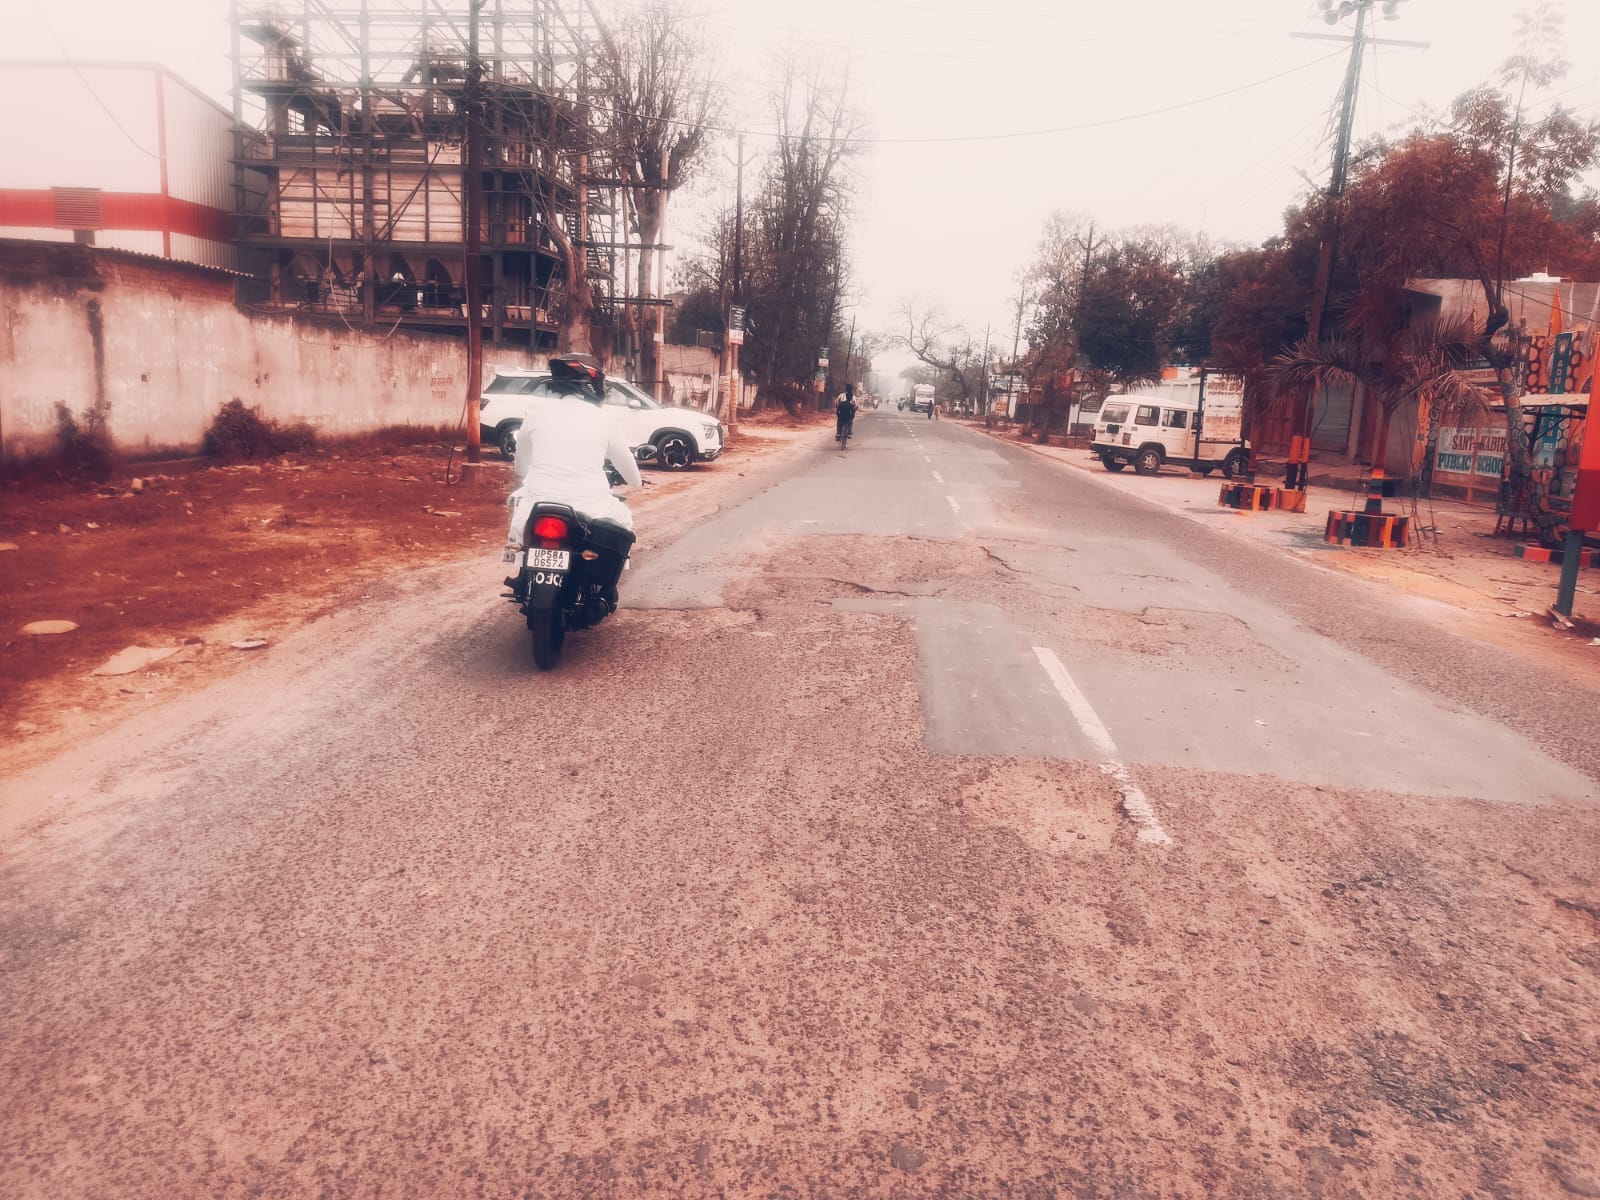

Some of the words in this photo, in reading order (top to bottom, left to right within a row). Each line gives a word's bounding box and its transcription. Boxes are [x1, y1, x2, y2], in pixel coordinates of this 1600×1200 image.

[1438, 453, 1472, 472] PUBLIC
[1477, 456, 1503, 474] SCHOO
[534, 550, 563, 560] UP58A
